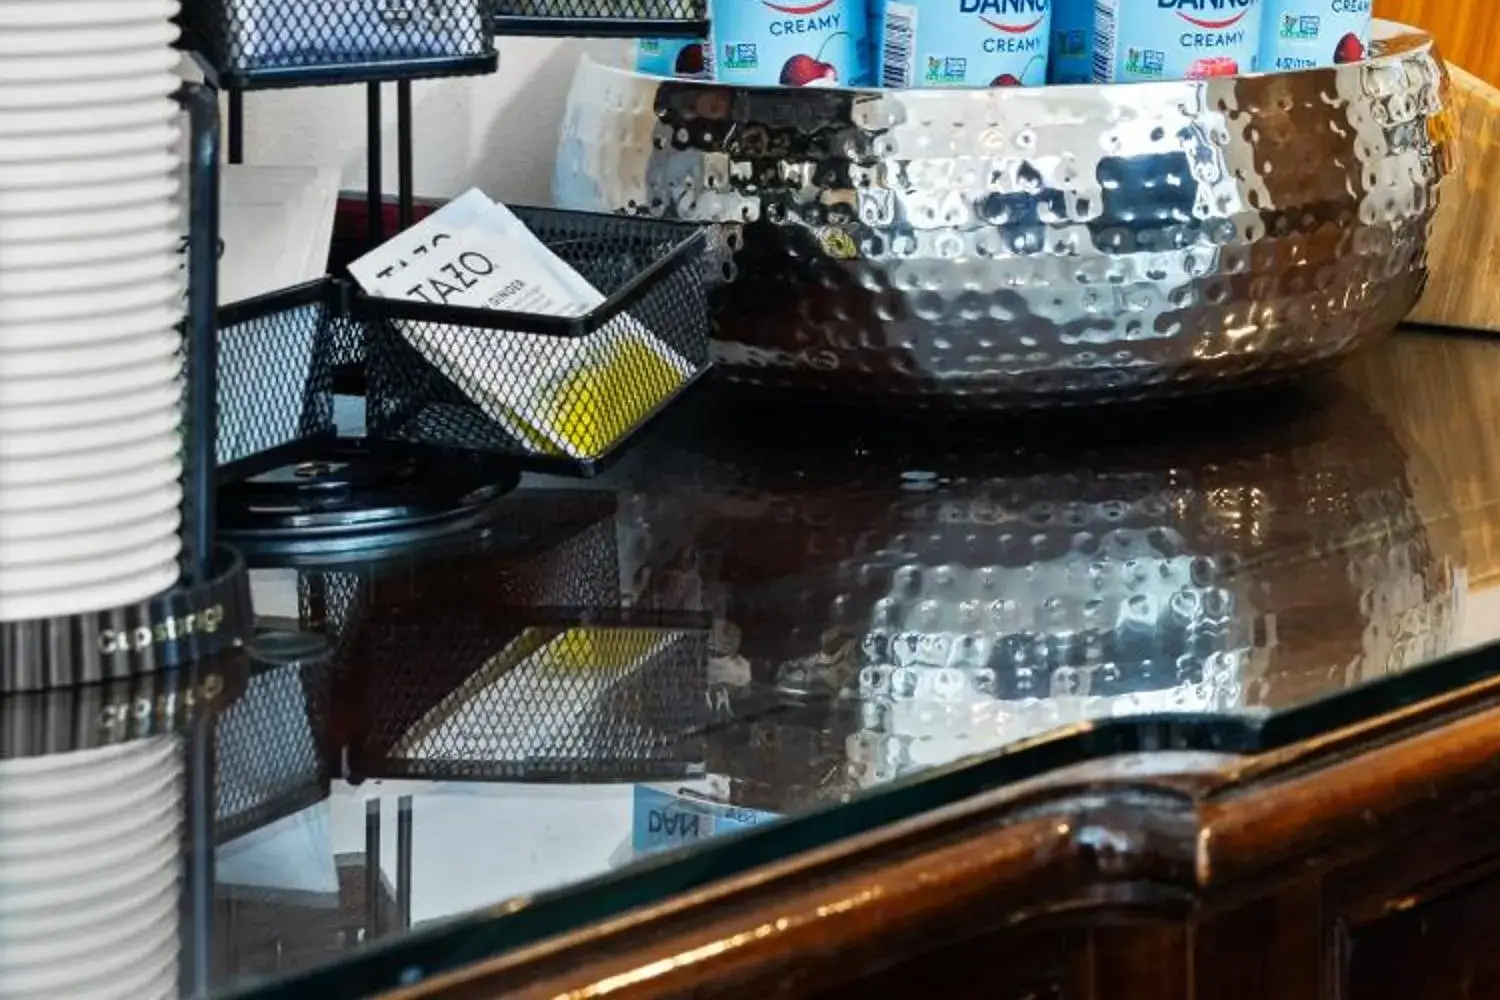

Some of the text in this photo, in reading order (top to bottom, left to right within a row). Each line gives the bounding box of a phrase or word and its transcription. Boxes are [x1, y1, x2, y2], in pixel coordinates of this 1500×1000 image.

[769, 13, 842, 36] CREAMY
[982, 35, 1042, 53] CREAMY
[1179, 29, 1245, 48] CREAMY
[406, 250, 494, 305] TAZO
